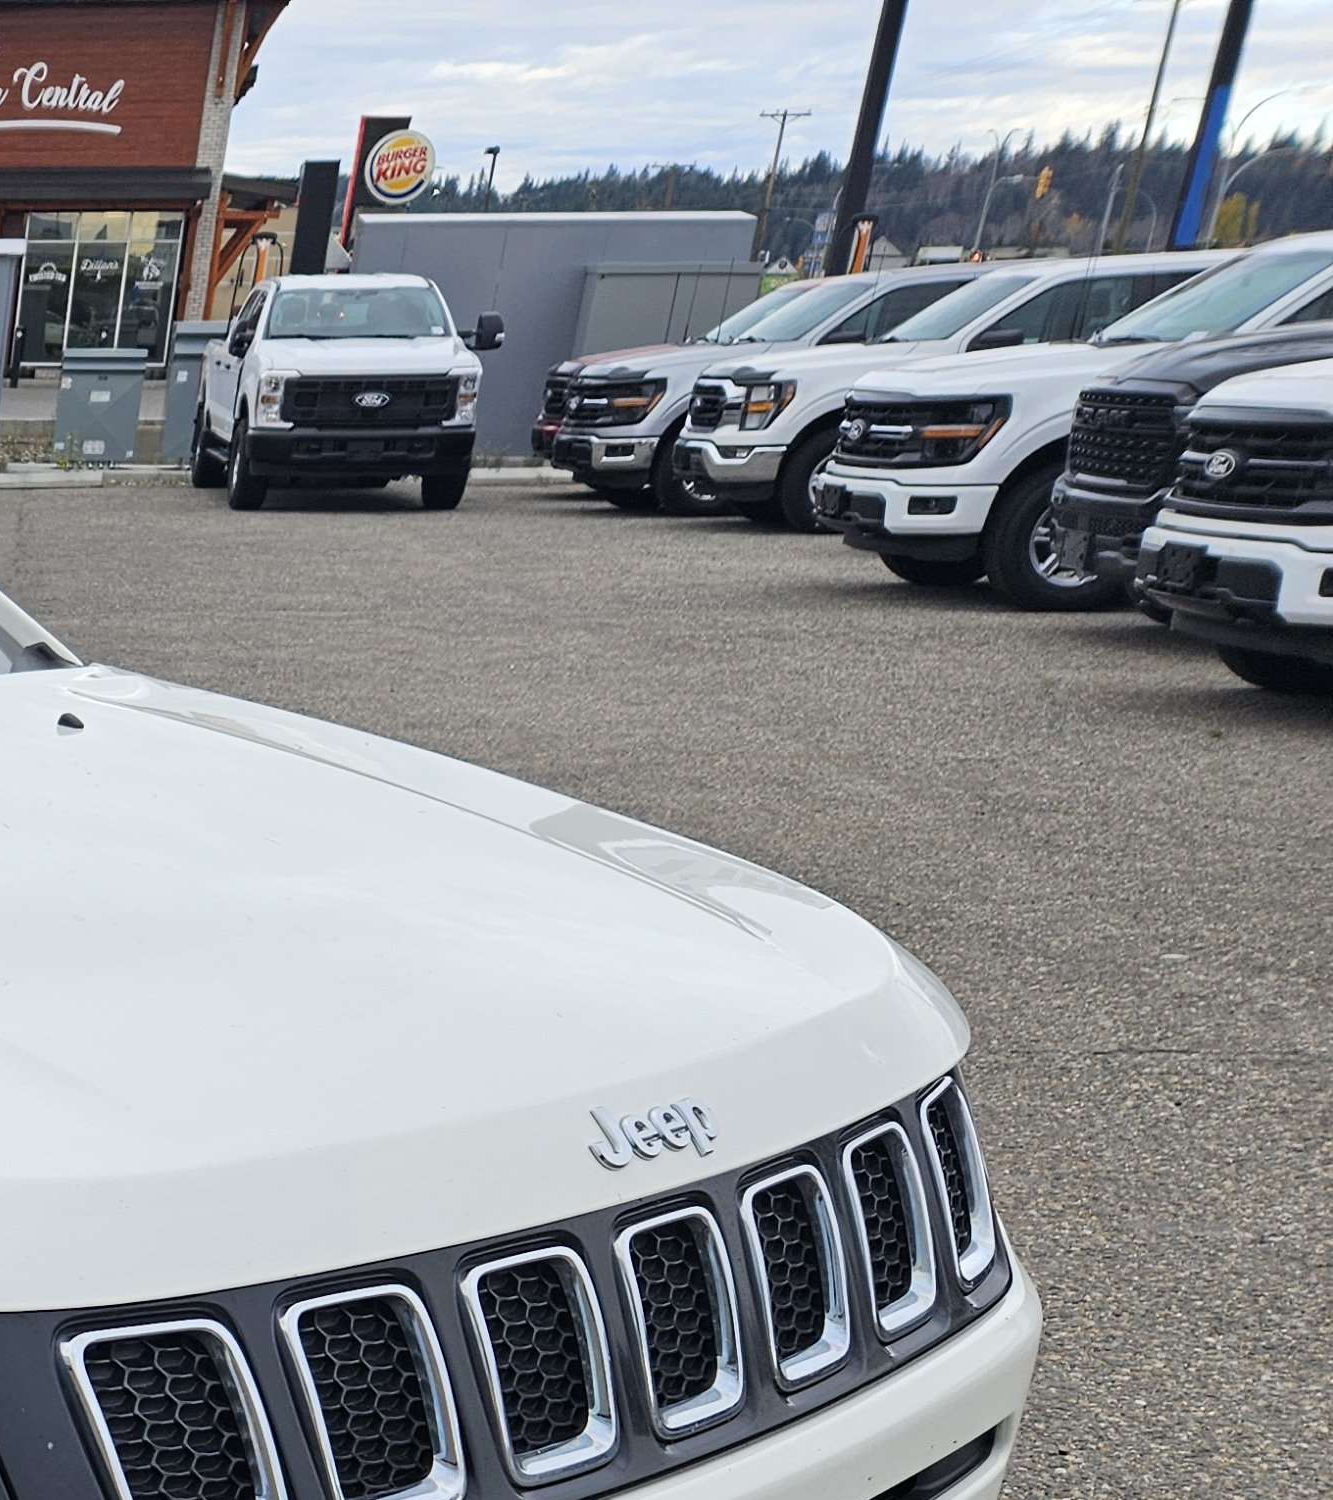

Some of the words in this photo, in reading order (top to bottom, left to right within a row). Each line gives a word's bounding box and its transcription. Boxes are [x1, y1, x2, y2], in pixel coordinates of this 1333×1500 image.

[12, 61, 126, 116] Central
[375, 158, 428, 183] KING
[376, 146, 428, 167] BURGER
[588, 1097, 718, 1171] Jeep
